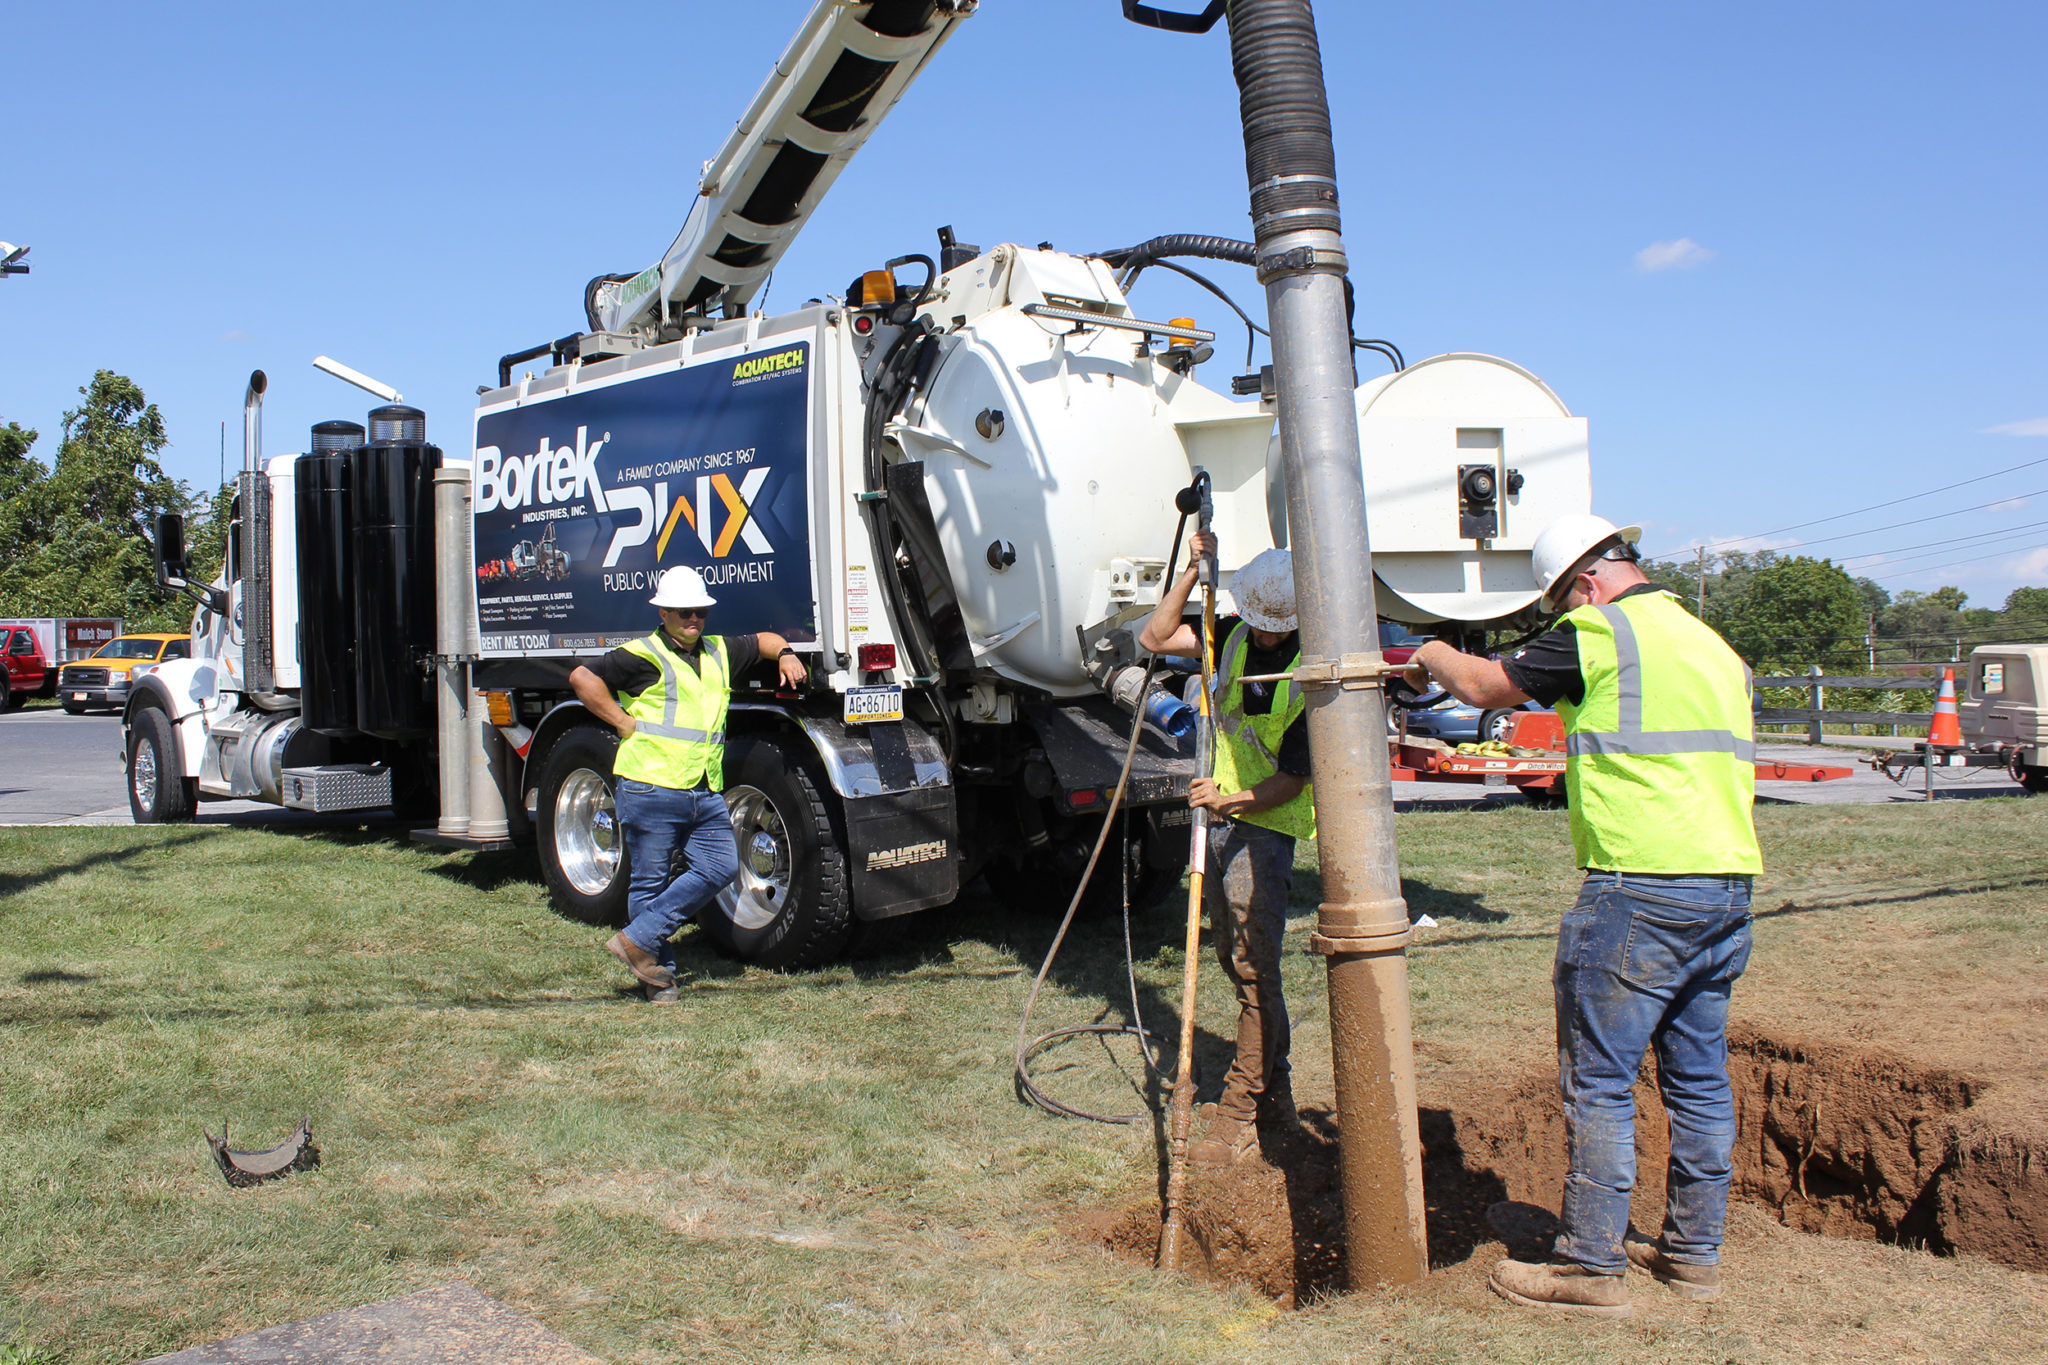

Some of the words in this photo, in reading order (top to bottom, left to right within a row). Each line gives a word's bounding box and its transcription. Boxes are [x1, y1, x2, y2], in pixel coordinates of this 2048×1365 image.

[732, 376, 761, 387] COMBINATION
[761, 371, 780, 380] JET/VAC
[781, 367, 802, 376] SYSTEMS
[475, 425, 609, 513] Bortek
[617, 469, 624, 482] A
[625, 464, 654, 482] FAMILY
[654, 457, 702, 477] COMPANY
[703, 451, 733, 470] SINCE
[736, 447, 756, 464] 1967
[522, 507, 570, 523] INDUSTRIES,
[571, 505, 588, 517] INC.
[603, 571, 644, 592] PUBLIC
[481, 636, 502, 650] RENT
[504, 635, 520, 649] ME
[521, 634, 550, 649] TODAY
[1527, 762, 1545, 770] Ditch
[1546, 762, 1565, 770] Witch
[865, 839, 947, 872] AQUATECH
